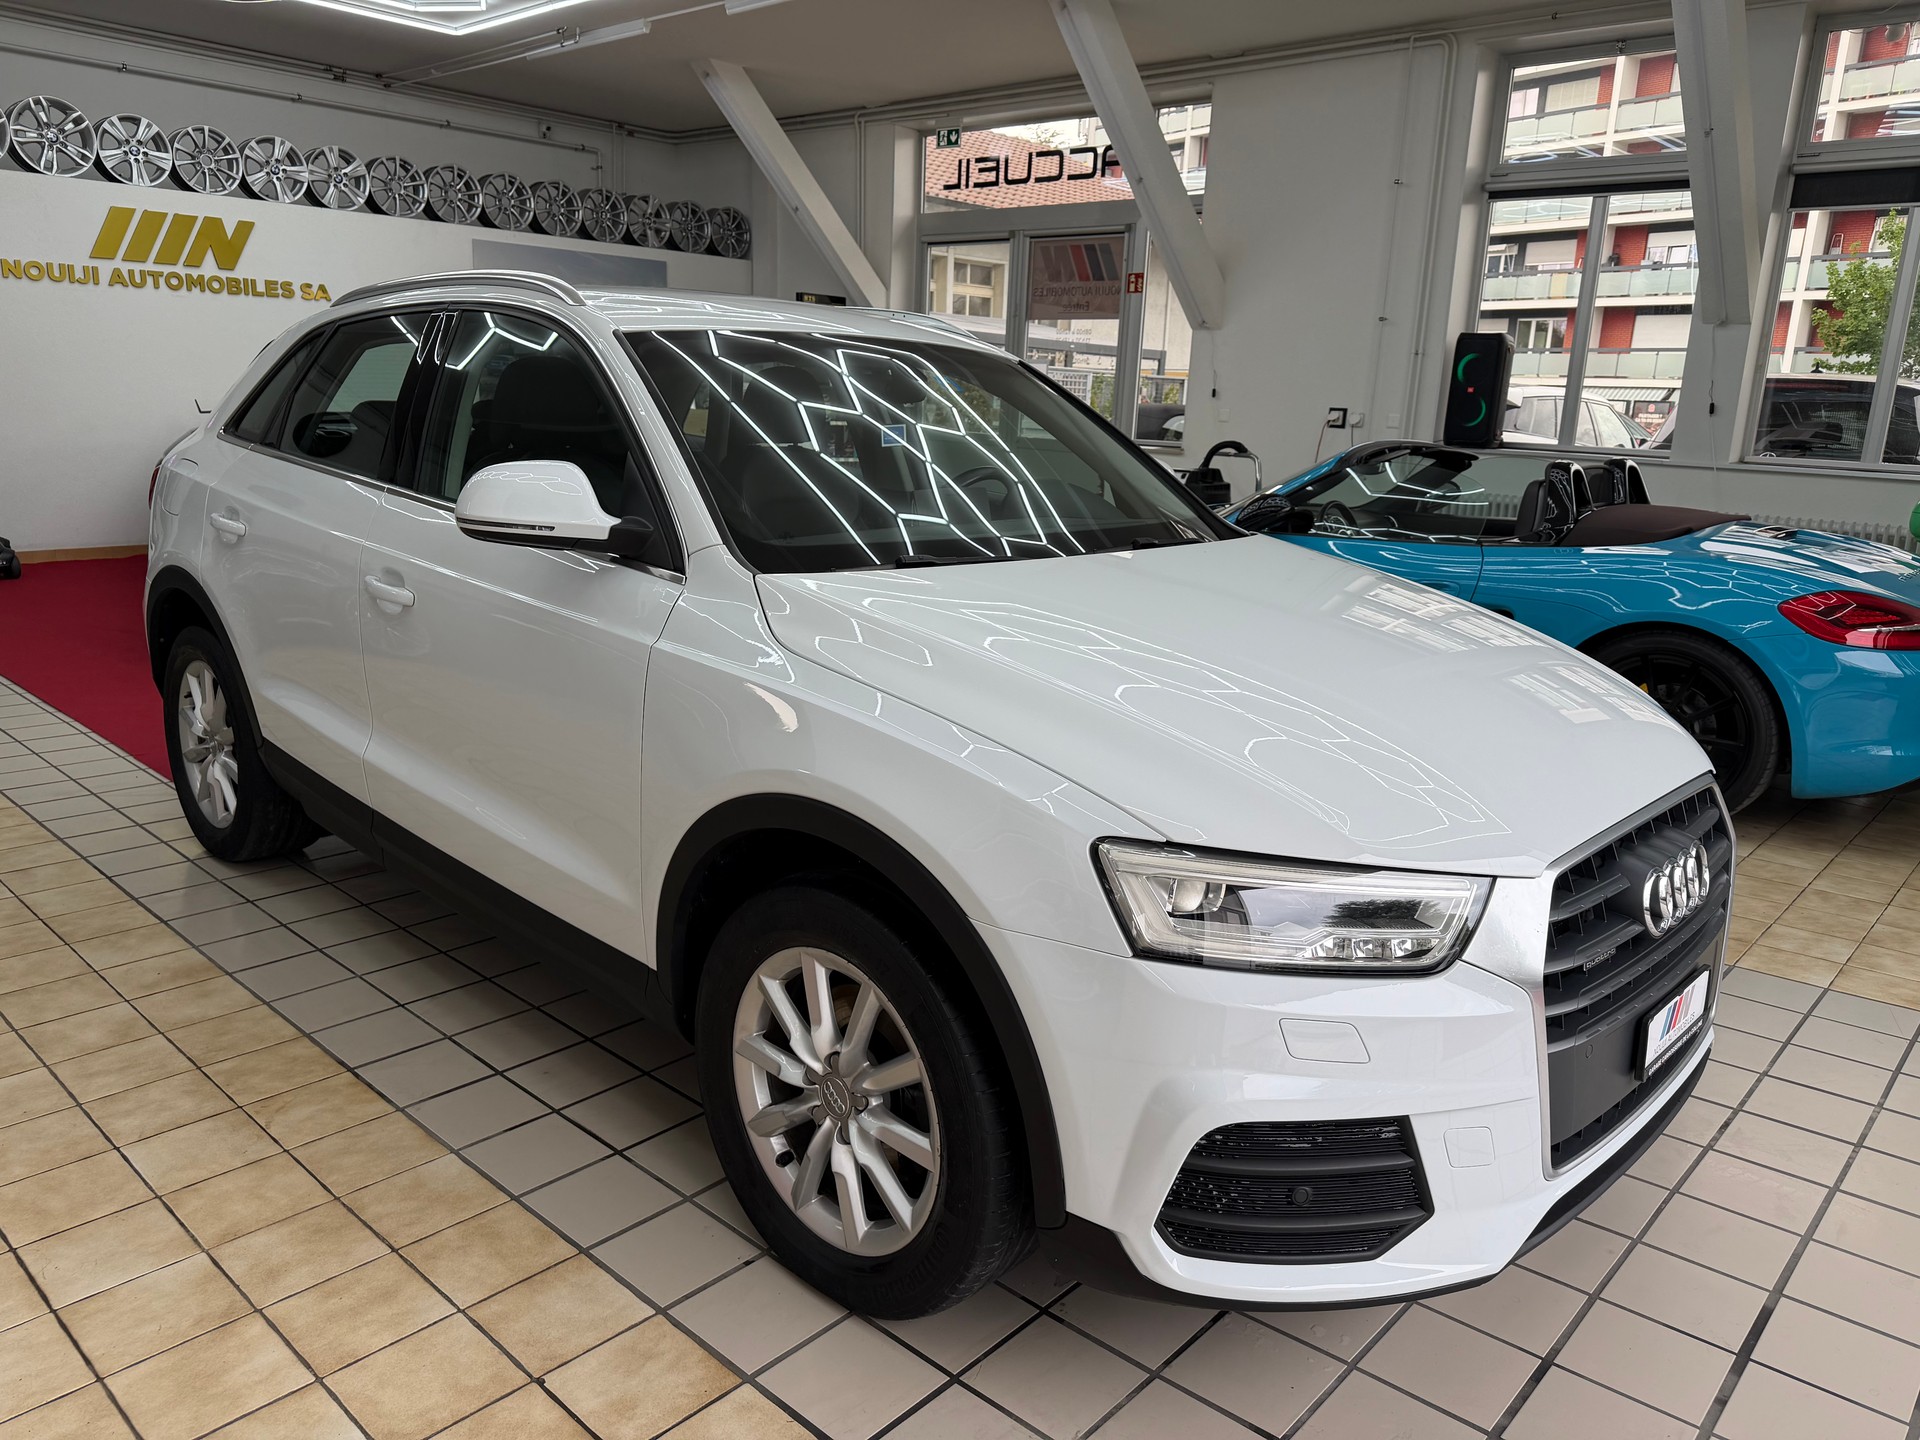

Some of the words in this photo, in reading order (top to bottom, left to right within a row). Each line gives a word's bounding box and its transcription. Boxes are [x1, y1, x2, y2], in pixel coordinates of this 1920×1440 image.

[1, 258, 100, 285] NOUIJI
[108, 267, 296, 299] AUTOMOBILES
[300, 282, 332, 301] SA
